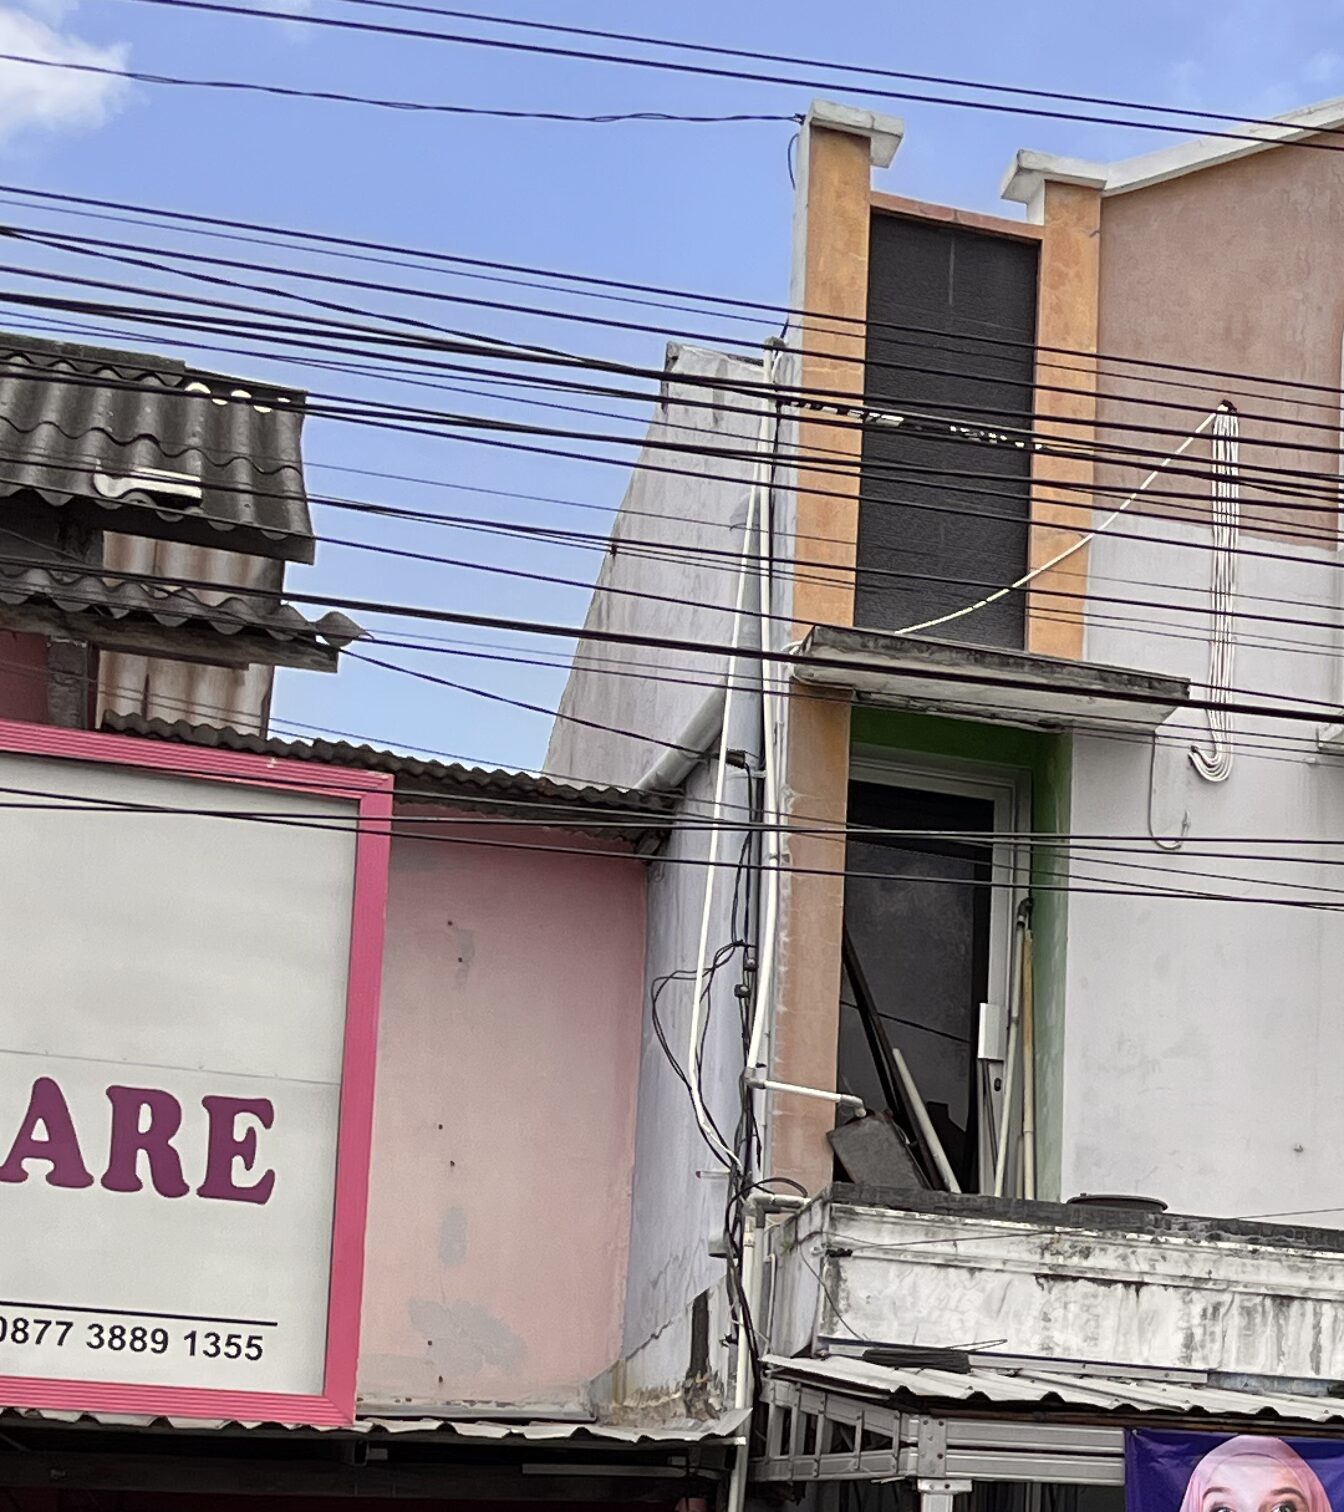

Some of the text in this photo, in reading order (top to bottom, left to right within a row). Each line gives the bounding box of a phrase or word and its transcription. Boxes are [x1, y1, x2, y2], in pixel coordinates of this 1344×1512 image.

[0, 1076, 275, 1205] ARE
[86, 1323, 169, 1354] 3889
[183, 1330, 263, 1361] 1355
